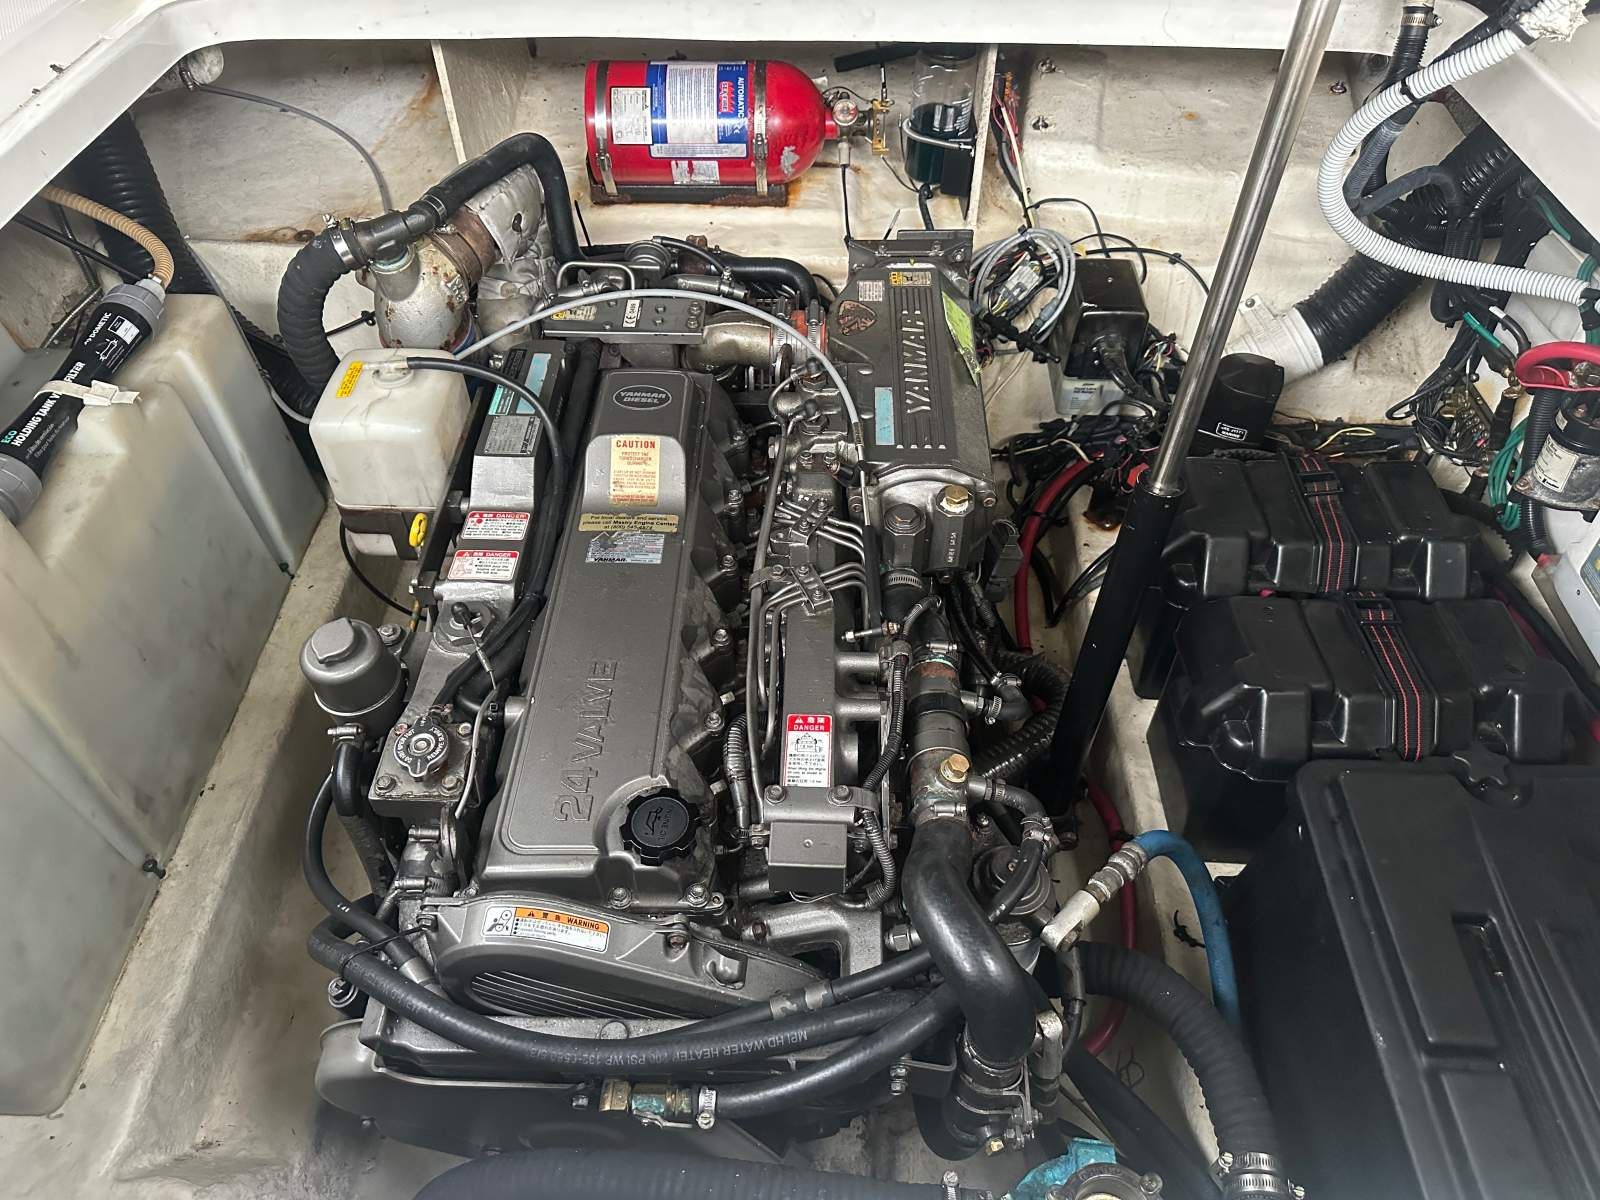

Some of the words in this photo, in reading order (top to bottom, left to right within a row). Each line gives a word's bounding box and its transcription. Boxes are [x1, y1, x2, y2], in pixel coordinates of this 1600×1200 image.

[737, 77, 745, 119] AUTOMATIC
[89, 312, 112, 338] DOMETIC
[905, 313, 932, 414] YANMAR
[620, 391, 667, 399] YANMAR
[11, 416, 43, 447] HOLDING
[34, 399, 57, 417] TANK
[64, 361, 86, 384] FILTER
[1, 430, 17, 444] ECO
[616, 440, 656, 449] CAUTION
[571, 660, 618, 763] VALVE
[553, 767, 599, 822] 24
[567, 917, 600, 930] WARNING
[721, 1037, 766, 1056] WATER
[768, 1034, 785, 1046] HD
[626, 1053, 647, 1065] PSI
[673, 1046, 720, 1061] HEATER
